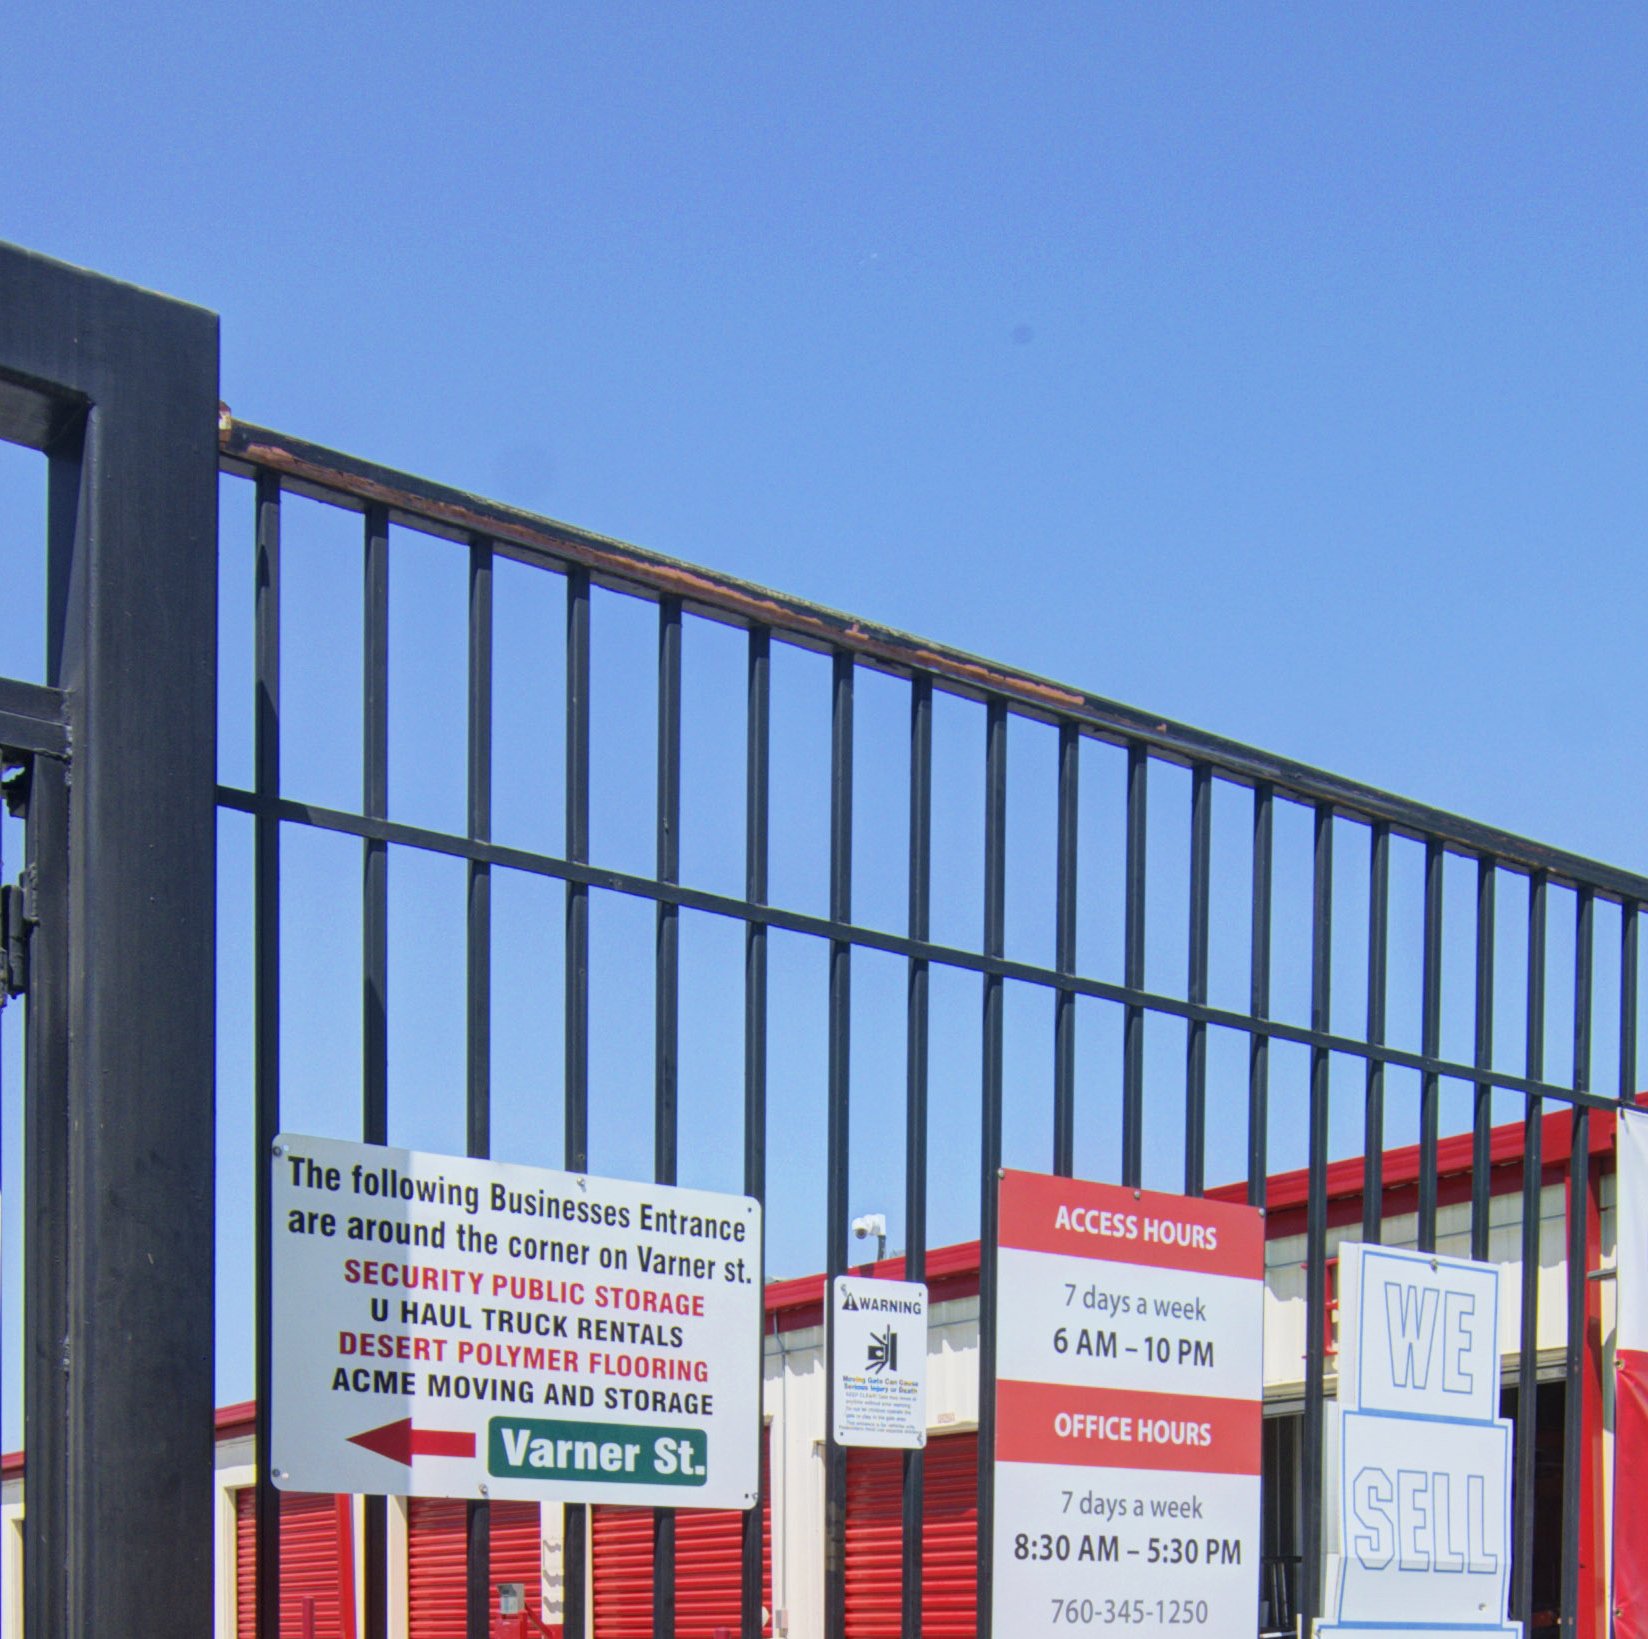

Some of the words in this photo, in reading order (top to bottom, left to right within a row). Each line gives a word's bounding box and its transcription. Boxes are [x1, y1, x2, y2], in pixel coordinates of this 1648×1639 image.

[288, 1156, 340, 1191] The
[351, 1164, 478, 1214] following
[491, 1182, 630, 1228] Businesses
[641, 1203, 745, 1242] Entrance
[288, 1210, 336, 1236] are
[347, 1216, 444, 1248] around
[456, 1224, 497, 1255] the
[509, 1236, 589, 1265] corner
[600, 1247, 627, 1270] on
[637, 1245, 715, 1279] Varner
[725, 1258, 751, 1284] st.
[1055, 1206, 1137, 1238] ACCESS
[1145, 1218, 1216, 1250] HOURS
[344, 1259, 483, 1294] SECURITY
[493, 1274, 584, 1305] PUBLIC
[595, 1286, 703, 1316] STORAGE
[860, 1298, 921, 1315] WARNING
[1065, 1284, 1076, 1306] 7
[1083, 1285, 1130, 1318] days
[1137, 1298, 1147, 1314] a
[1154, 1297, 1206, 1321] week
[371, 1298, 388, 1321] U
[401, 1300, 471, 1328] HAUL
[481, 1308, 567, 1337] TRUCK
[578, 1318, 682, 1348] RENTALS
[1384, 1282, 1475, 1394] WE
[340, 1332, 447, 1361] DESERT
[458, 1341, 578, 1372] POLYMER
[590, 1352, 707, 1382] FLOORING
[1054, 1328, 1068, 1353] 6
[1076, 1329, 1117, 1358] AM
[1145, 1336, 1170, 1363] 10
[1179, 1339, 1213, 1367] PM
[332, 1368, 415, 1395] ACME
[428, 1374, 533, 1403] MOVING
[544, 1383, 594, 1407] AND
[605, 1387, 712, 1415] STORAGE
[502, 1428, 640, 1471] Varner
[654, 1438, 705, 1475] St.
[1055, 1413, 1131, 1440] OFFICE
[1139, 1419, 1211, 1446] HOURS
[1062, 1491, 1073, 1513] 7
[1080, 1490, 1127, 1522] days
[1133, 1500, 1143, 1516] a
[1151, 1495, 1202, 1519] week
[1354, 1467, 1497, 1573] SELL
[1015, 1534, 1070, 1561] 8:30
[1078, 1535, 1119, 1561] AM
[1148, 1538, 1199, 1564] 5:30
[1207, 1539, 1241, 1564] PM
[1052, 1599, 1208, 1624] 760-345-1250
